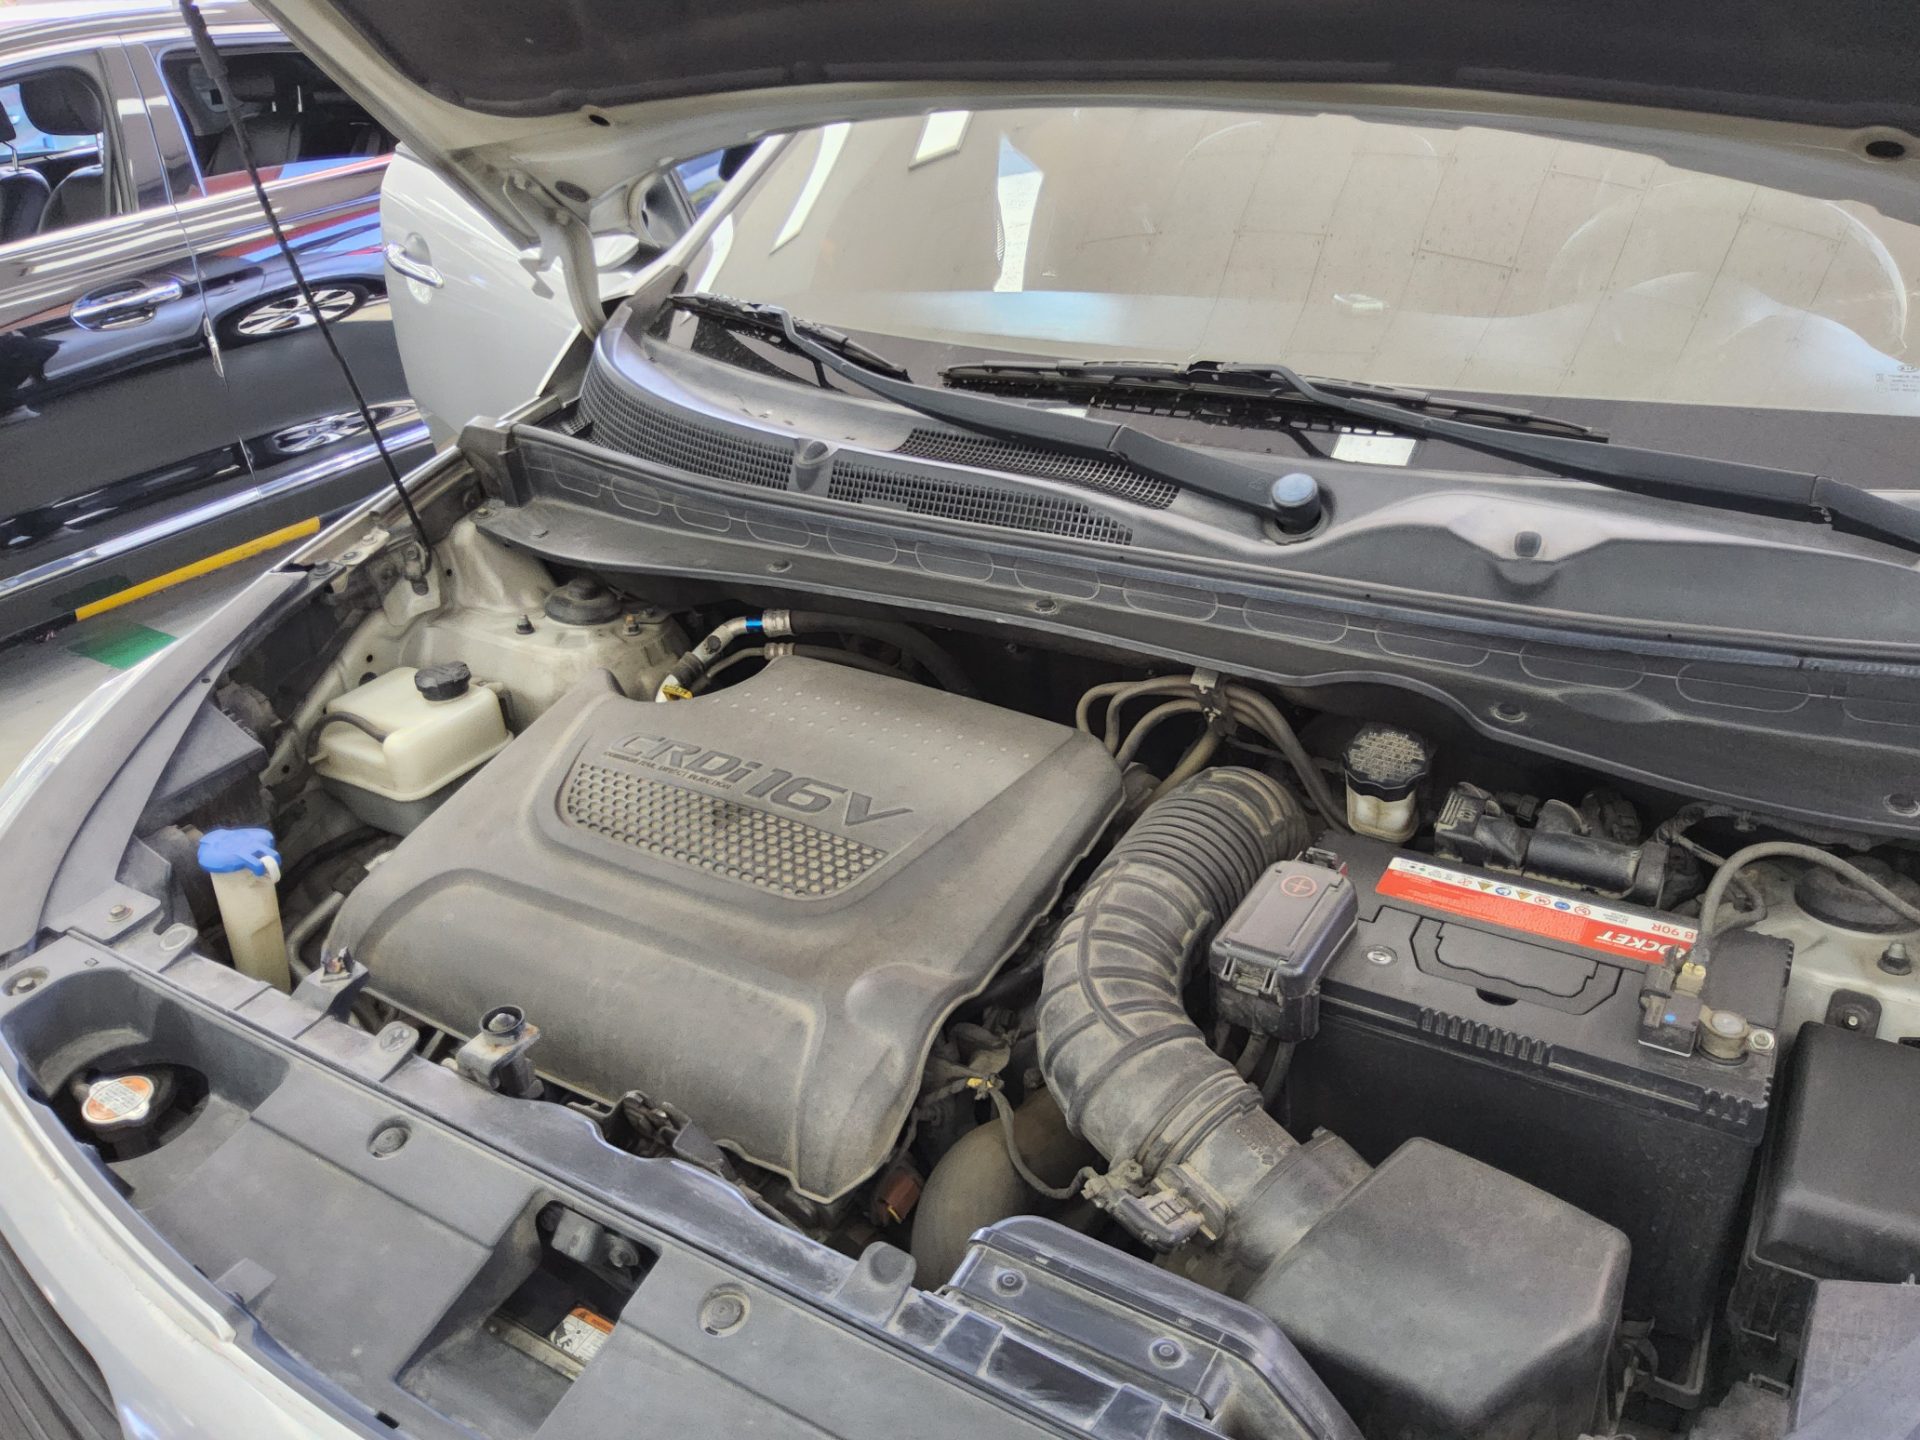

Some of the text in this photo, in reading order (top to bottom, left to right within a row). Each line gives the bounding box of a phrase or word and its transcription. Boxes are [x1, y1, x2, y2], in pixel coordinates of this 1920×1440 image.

[610, 732, 914, 826] CRDi 16V
[1651, 923, 1680, 936] 90R
